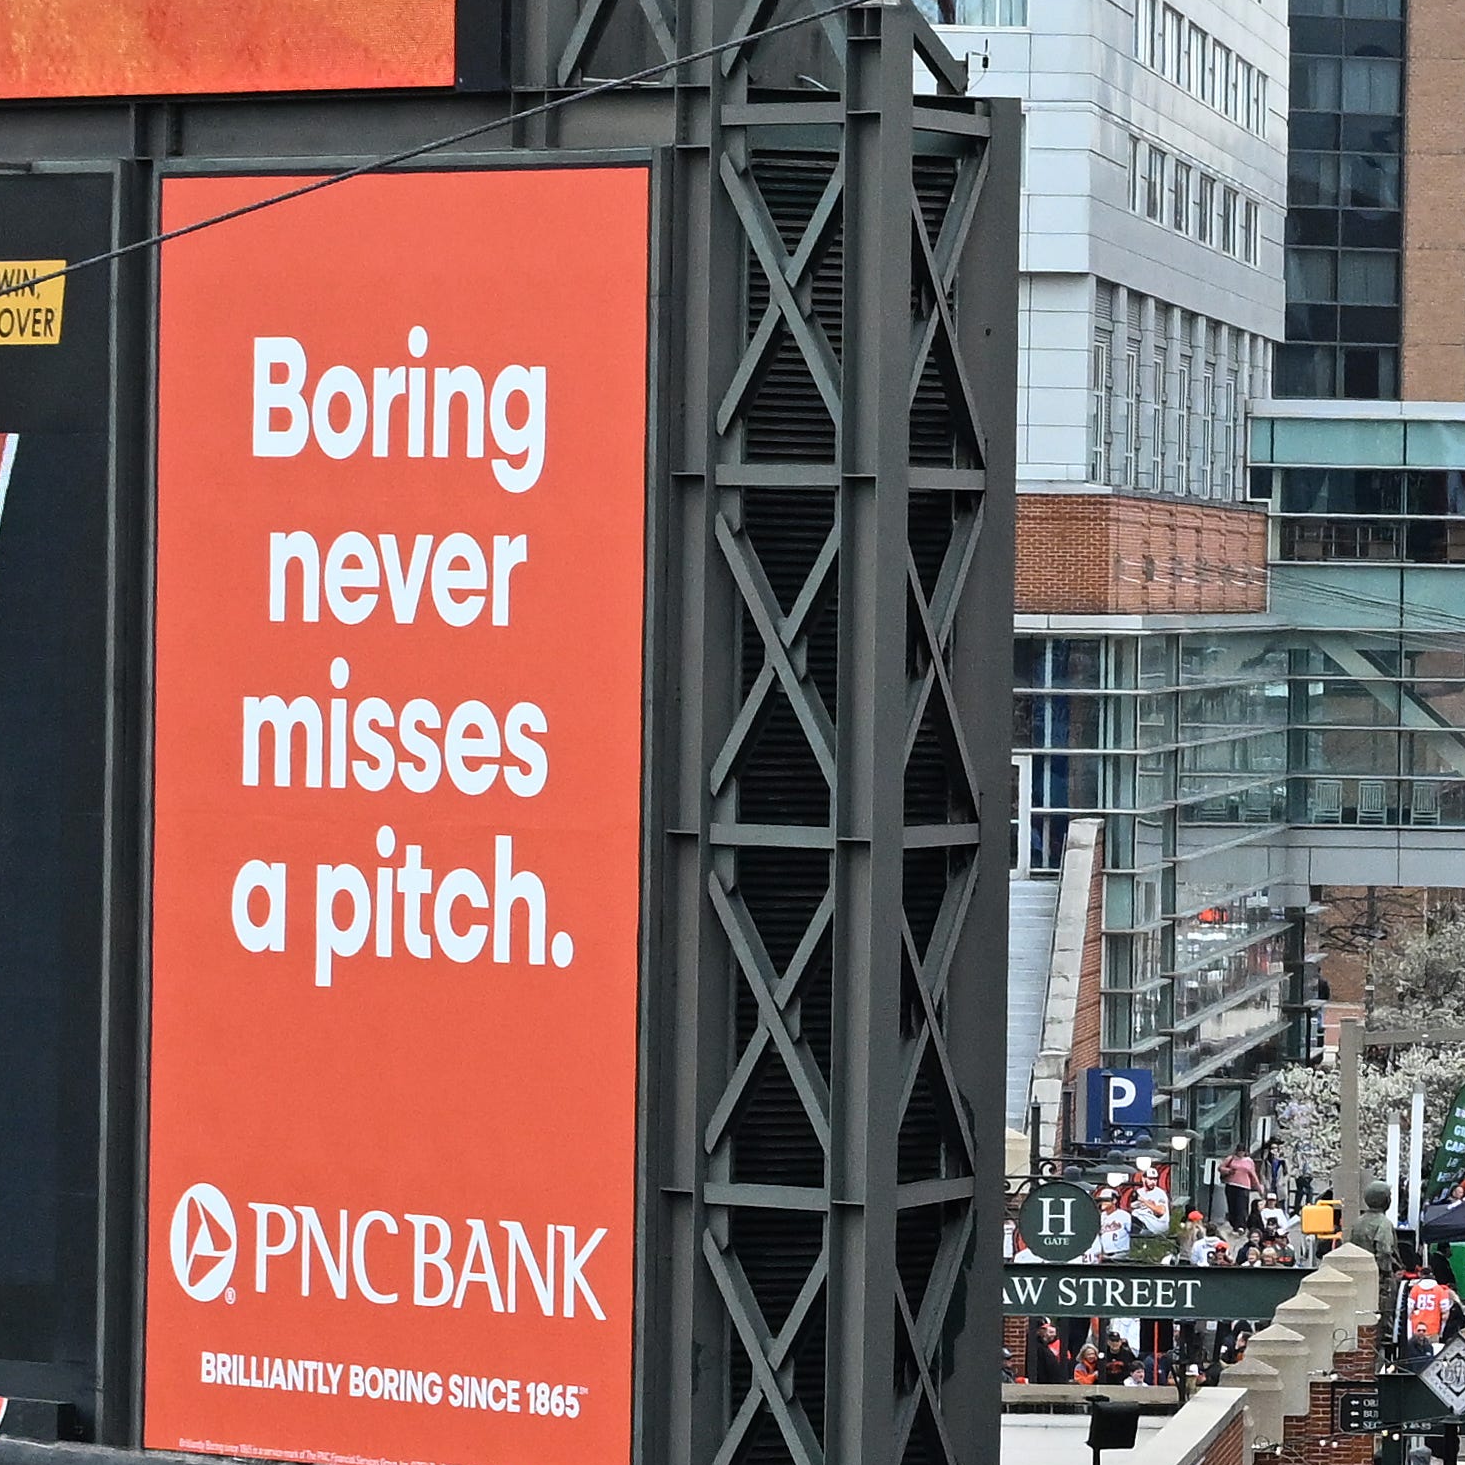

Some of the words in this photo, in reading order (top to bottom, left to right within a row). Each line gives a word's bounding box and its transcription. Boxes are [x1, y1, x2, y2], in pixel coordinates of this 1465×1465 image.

[251, 326, 548, 494] Boring
[268, 531, 528, 626] never
[241, 656, 549, 798] misses
[231, 858, 287, 954] a
[313, 825, 575, 988] pitch.
[1109, 1077, 1137, 1124] P
[1037, 1197, 1077, 1236] H
[1043, 1237, 1070, 1246] GATE
[248, 1200, 399, 1306] PNC
[402, 1212, 609, 1322] BANK
[1058, 1277, 1202, 1309] STREET
[1415, 1294, 1435, 1313] 85
[200, 1351, 344, 1396] BRILLIANTLY
[348, 1365, 445, 1405] BORING
[447, 1374, 522, 1413] SINCE
